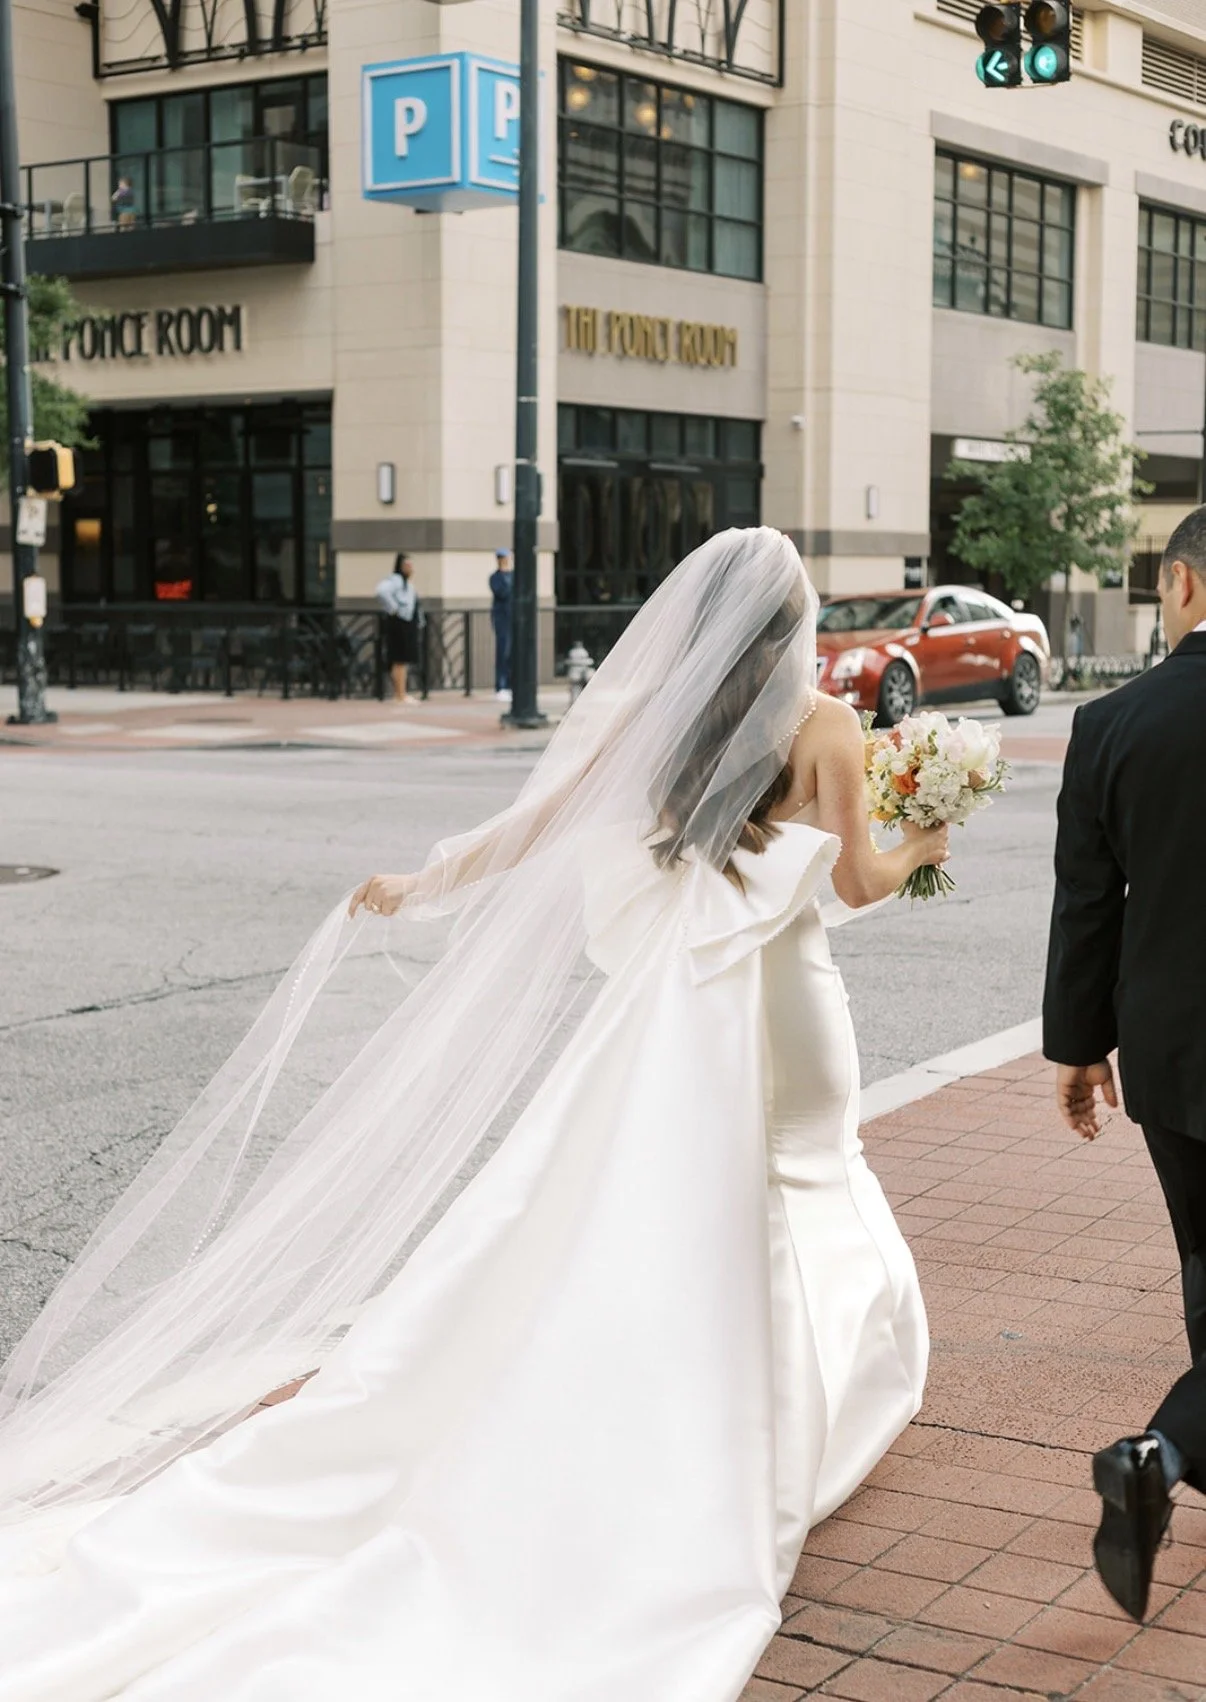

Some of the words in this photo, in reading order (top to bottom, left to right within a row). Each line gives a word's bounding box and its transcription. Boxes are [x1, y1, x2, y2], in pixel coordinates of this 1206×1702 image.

[394, 96, 428, 159] P
[156, 303, 243, 356] ROOM
[679, 319, 737, 368] ROOM
